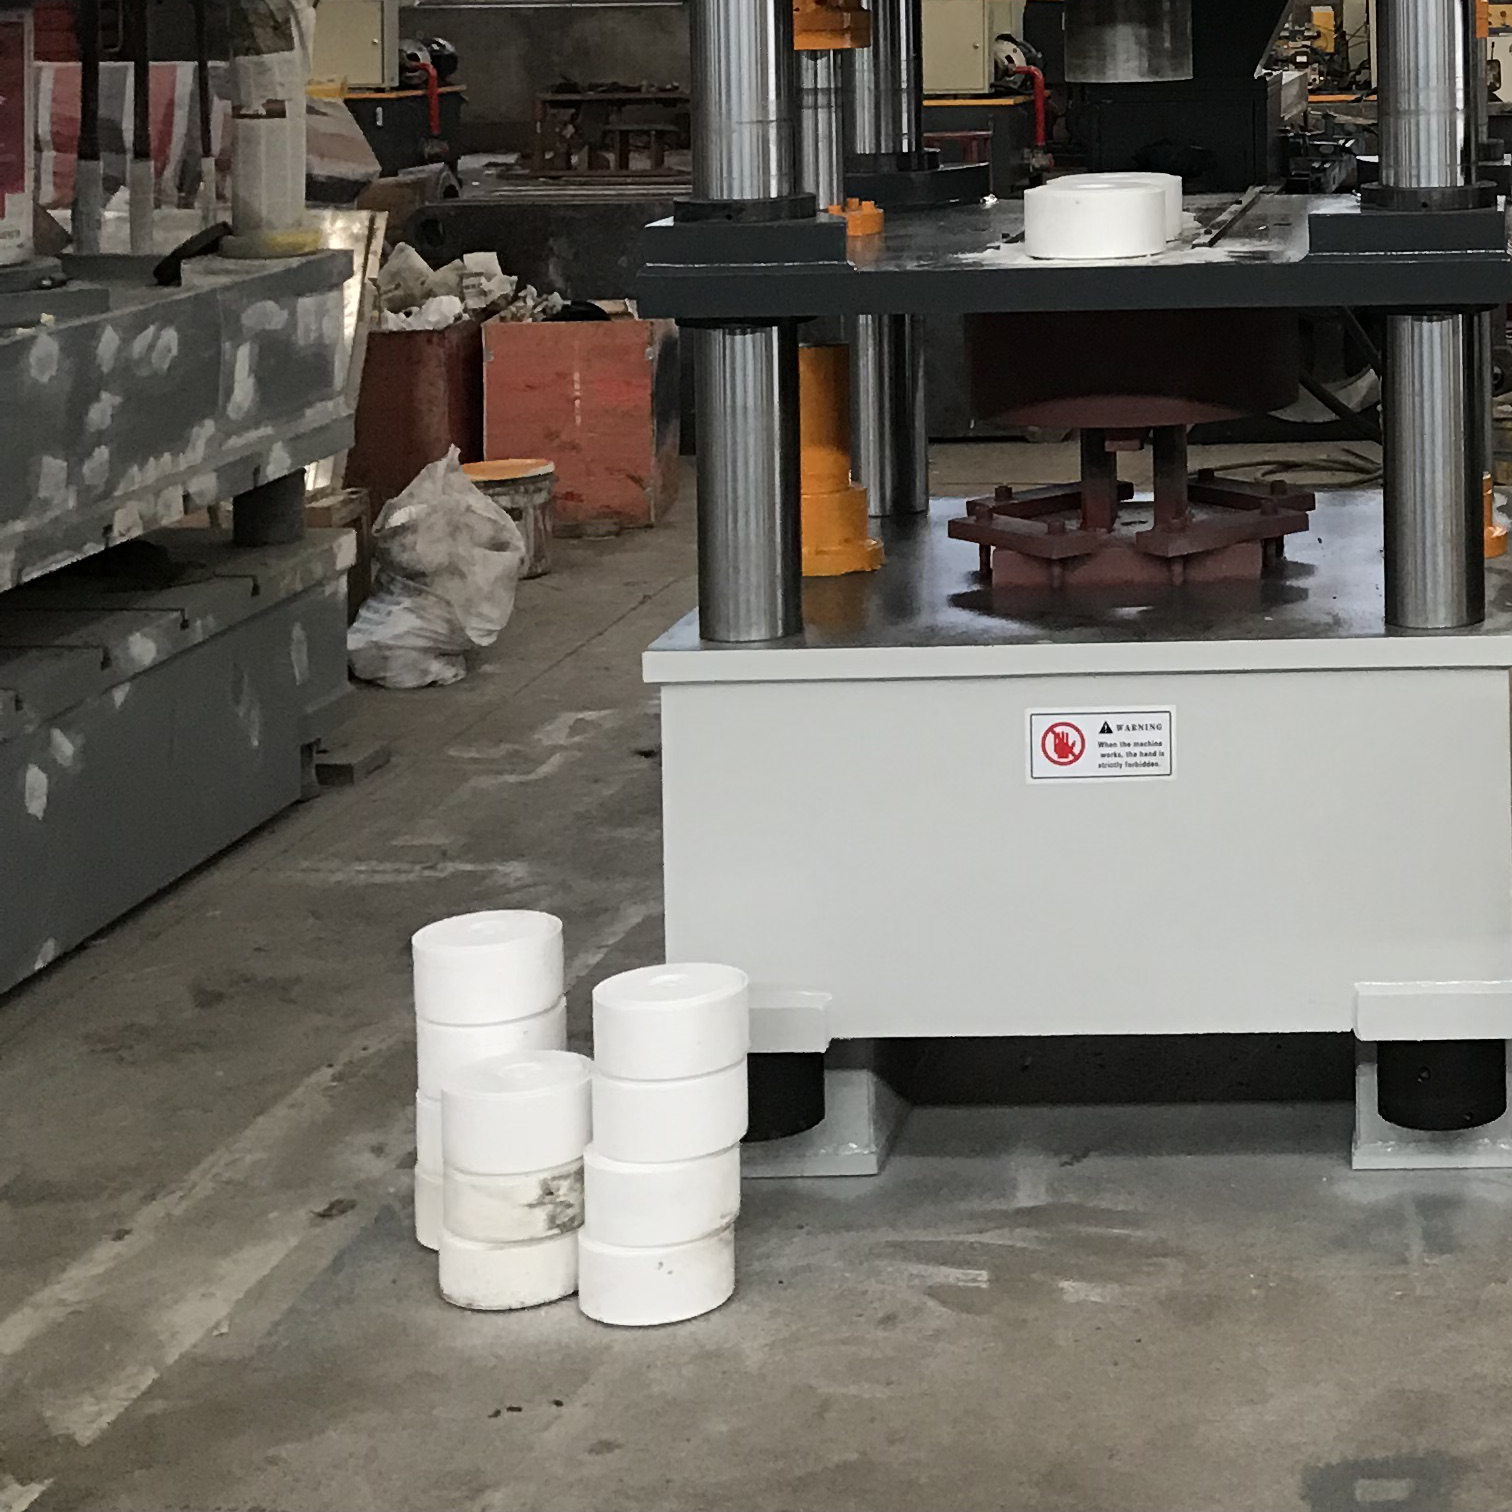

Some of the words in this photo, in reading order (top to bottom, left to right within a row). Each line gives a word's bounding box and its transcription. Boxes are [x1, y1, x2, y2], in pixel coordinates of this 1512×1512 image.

[1116, 723, 1163, 732] WARNING
[1133, 740, 1163, 748] machine
[1139, 750, 1157, 758] hand
